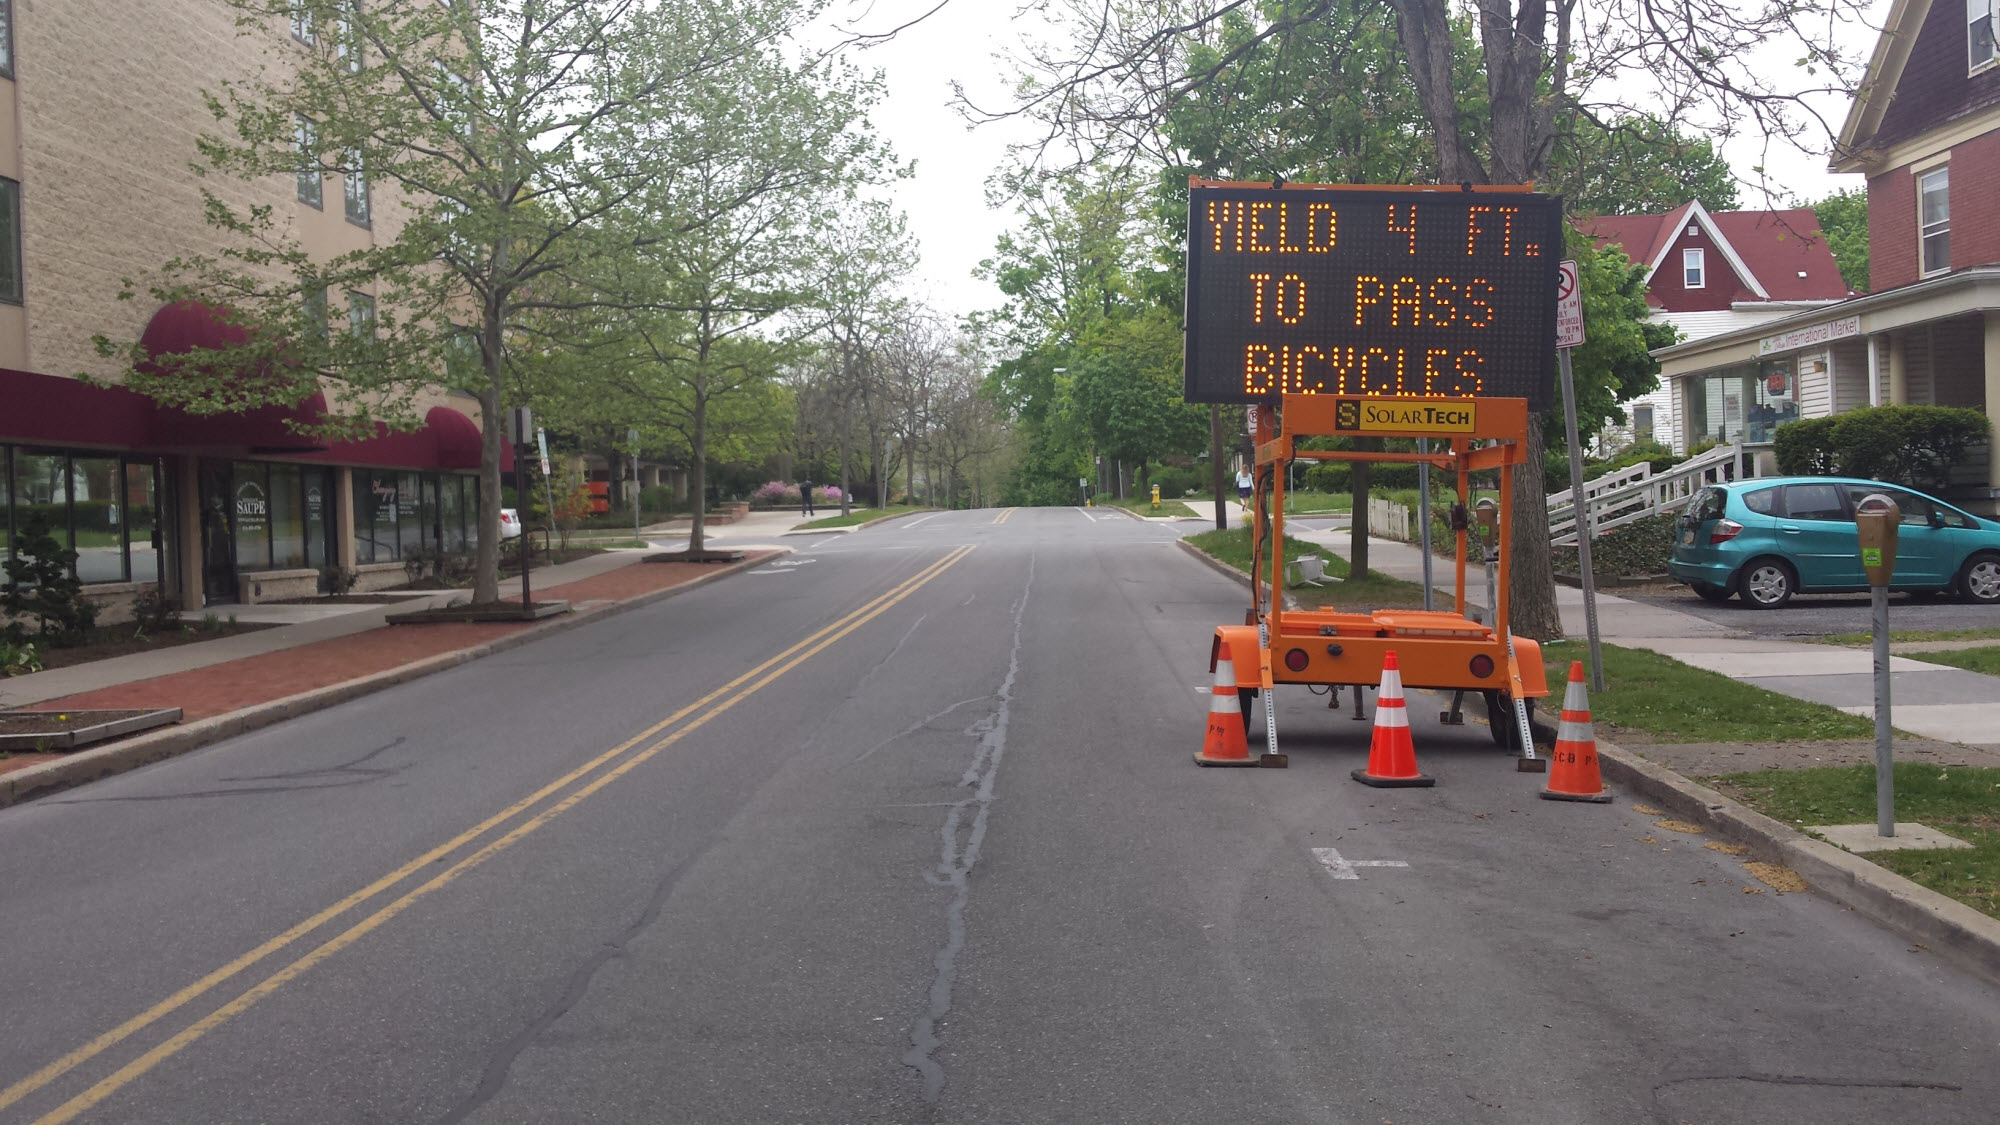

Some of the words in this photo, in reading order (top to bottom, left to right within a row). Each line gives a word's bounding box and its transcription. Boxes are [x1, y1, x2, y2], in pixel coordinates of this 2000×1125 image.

[1208, 201, 1337, 253] YIELD
[1388, 204, 1417, 255] 4
[1466, 205, 1540, 257] FT.
[1249, 273, 1306, 325] TO
[1355, 275, 1495, 328] PASS
[1785, 324, 1829, 347] International
[1830, 318, 1858, 338] Market
[1244, 343, 1484, 397] BICYCLES
[1365, 405, 1470, 425] SOLARTECH
[236, 500, 266, 514] SAUPE
